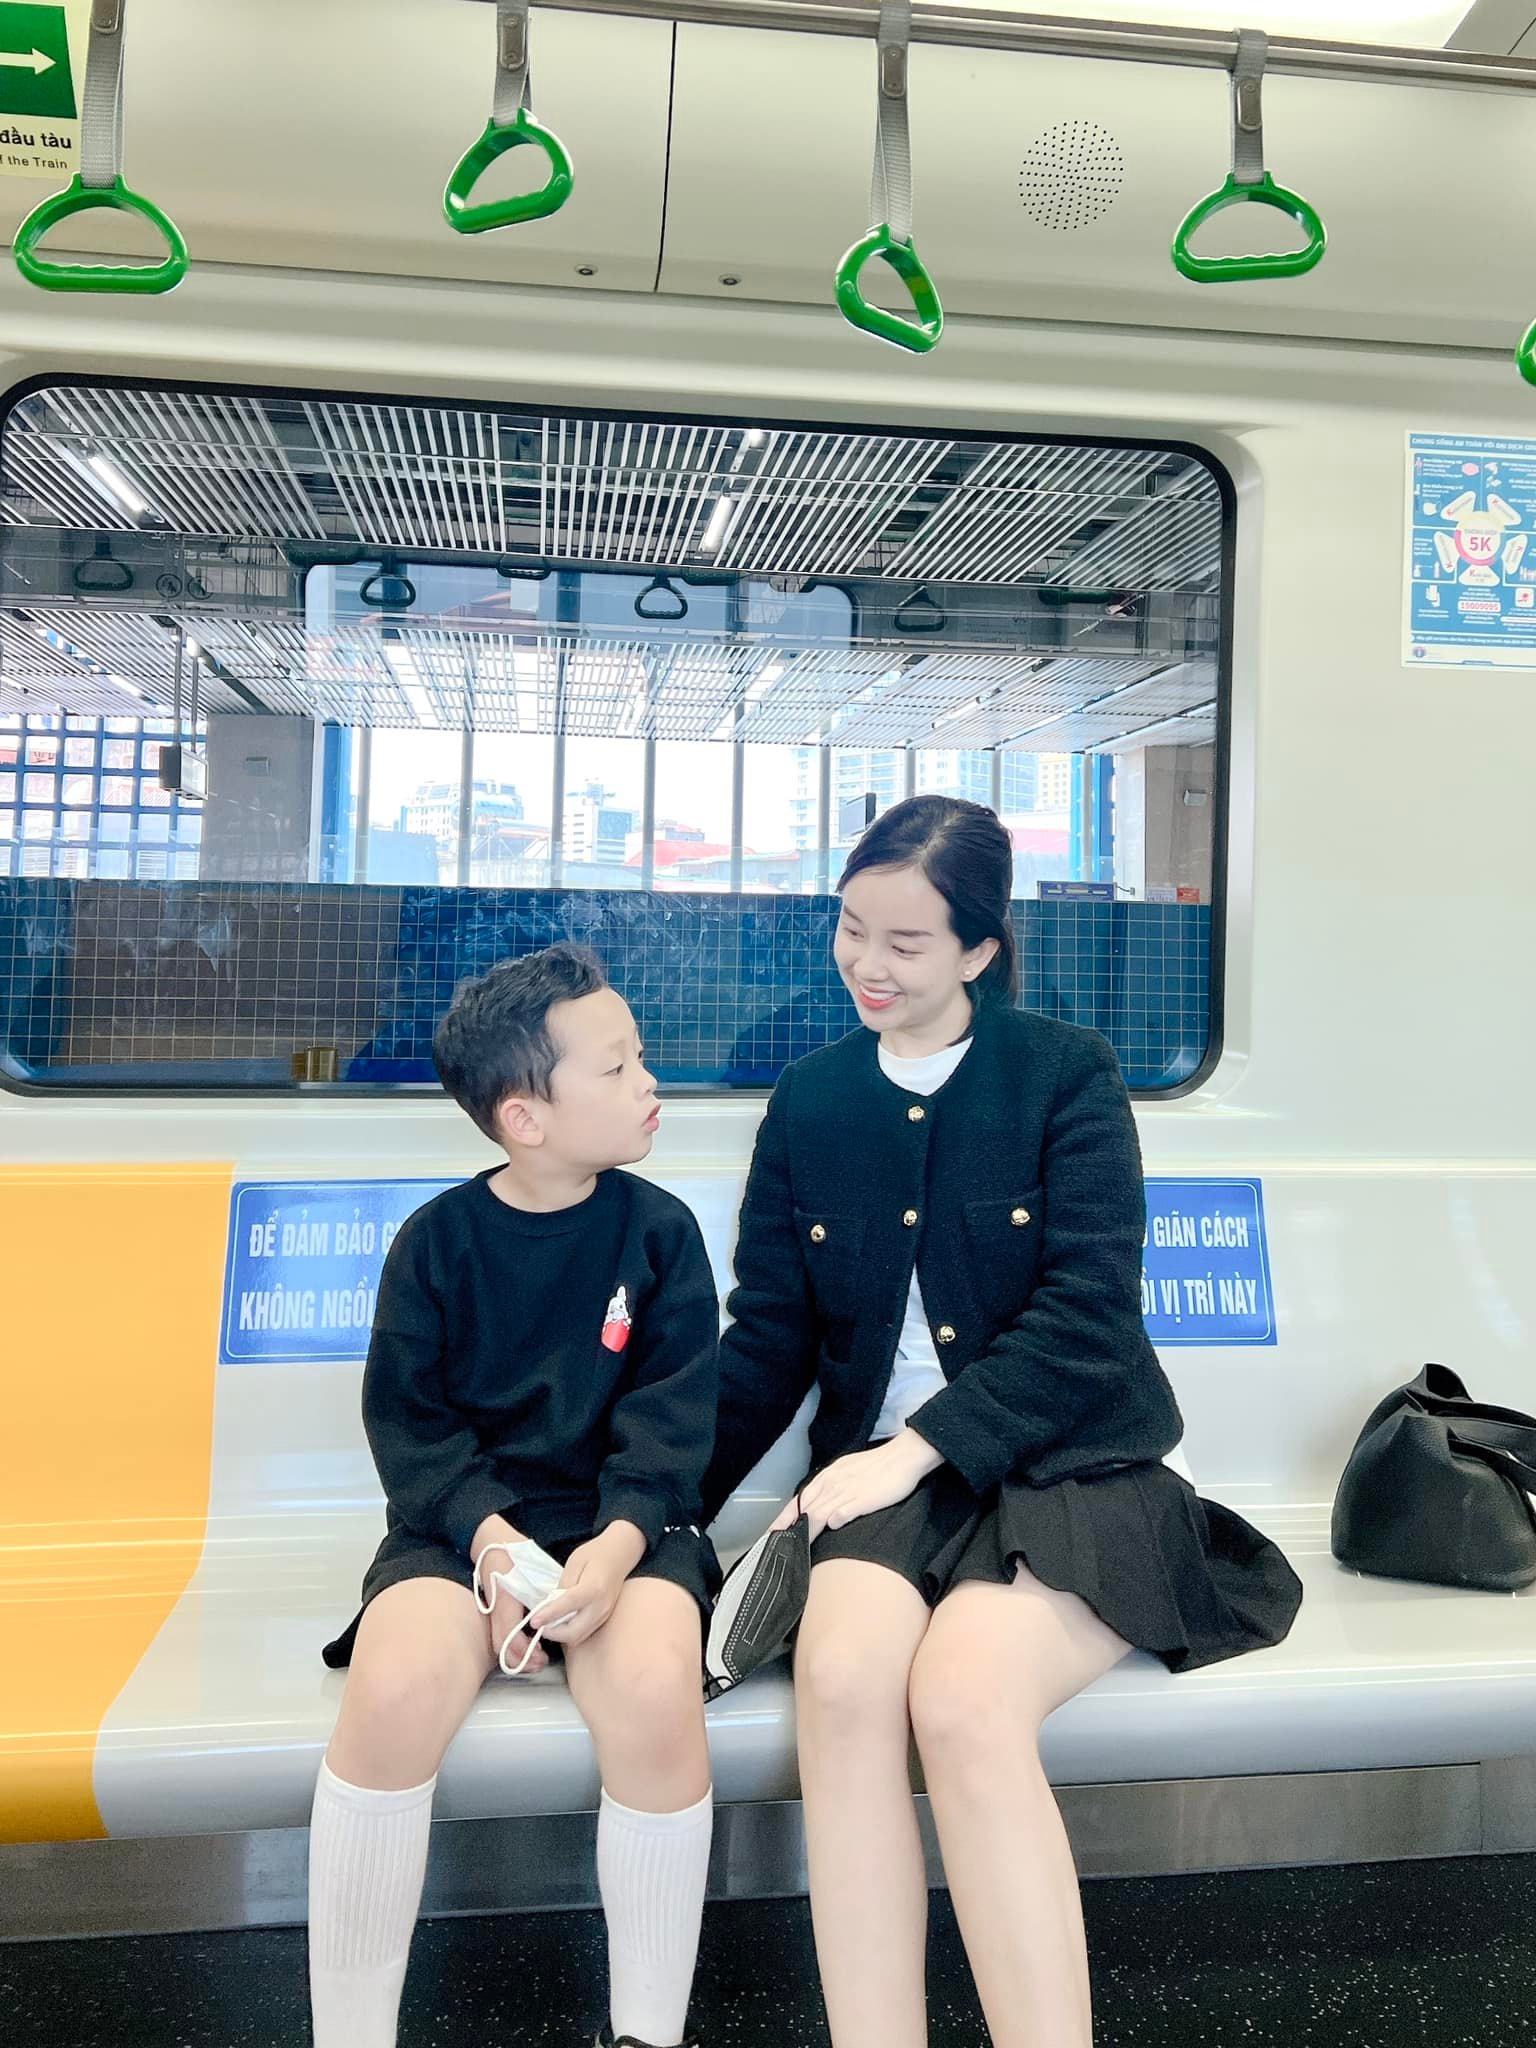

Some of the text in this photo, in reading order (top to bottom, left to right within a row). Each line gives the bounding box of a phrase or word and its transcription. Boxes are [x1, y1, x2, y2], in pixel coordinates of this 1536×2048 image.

[0, 126, 72, 149] đầu tàu
[7, 155, 30, 167] the
[32, 156, 68, 169] Train
[1469, 536, 1492, 552] 5K
[249, 1210, 279, 1258] ĐỂ
[281, 1209, 329, 1257] ĐẢM
[334, 1208, 375, 1256] BẢO
[1153, 1210, 1197, 1249] GIÃN
[1200, 1210, 1249, 1249] CÁCH
[239, 1283, 316, 1331] KHÔNG
[1160, 1279, 1182, 1324] VỊ
[1183, 1271, 1215, 1316] TRÍ
[1218, 1271, 1257, 1316] NÀY
